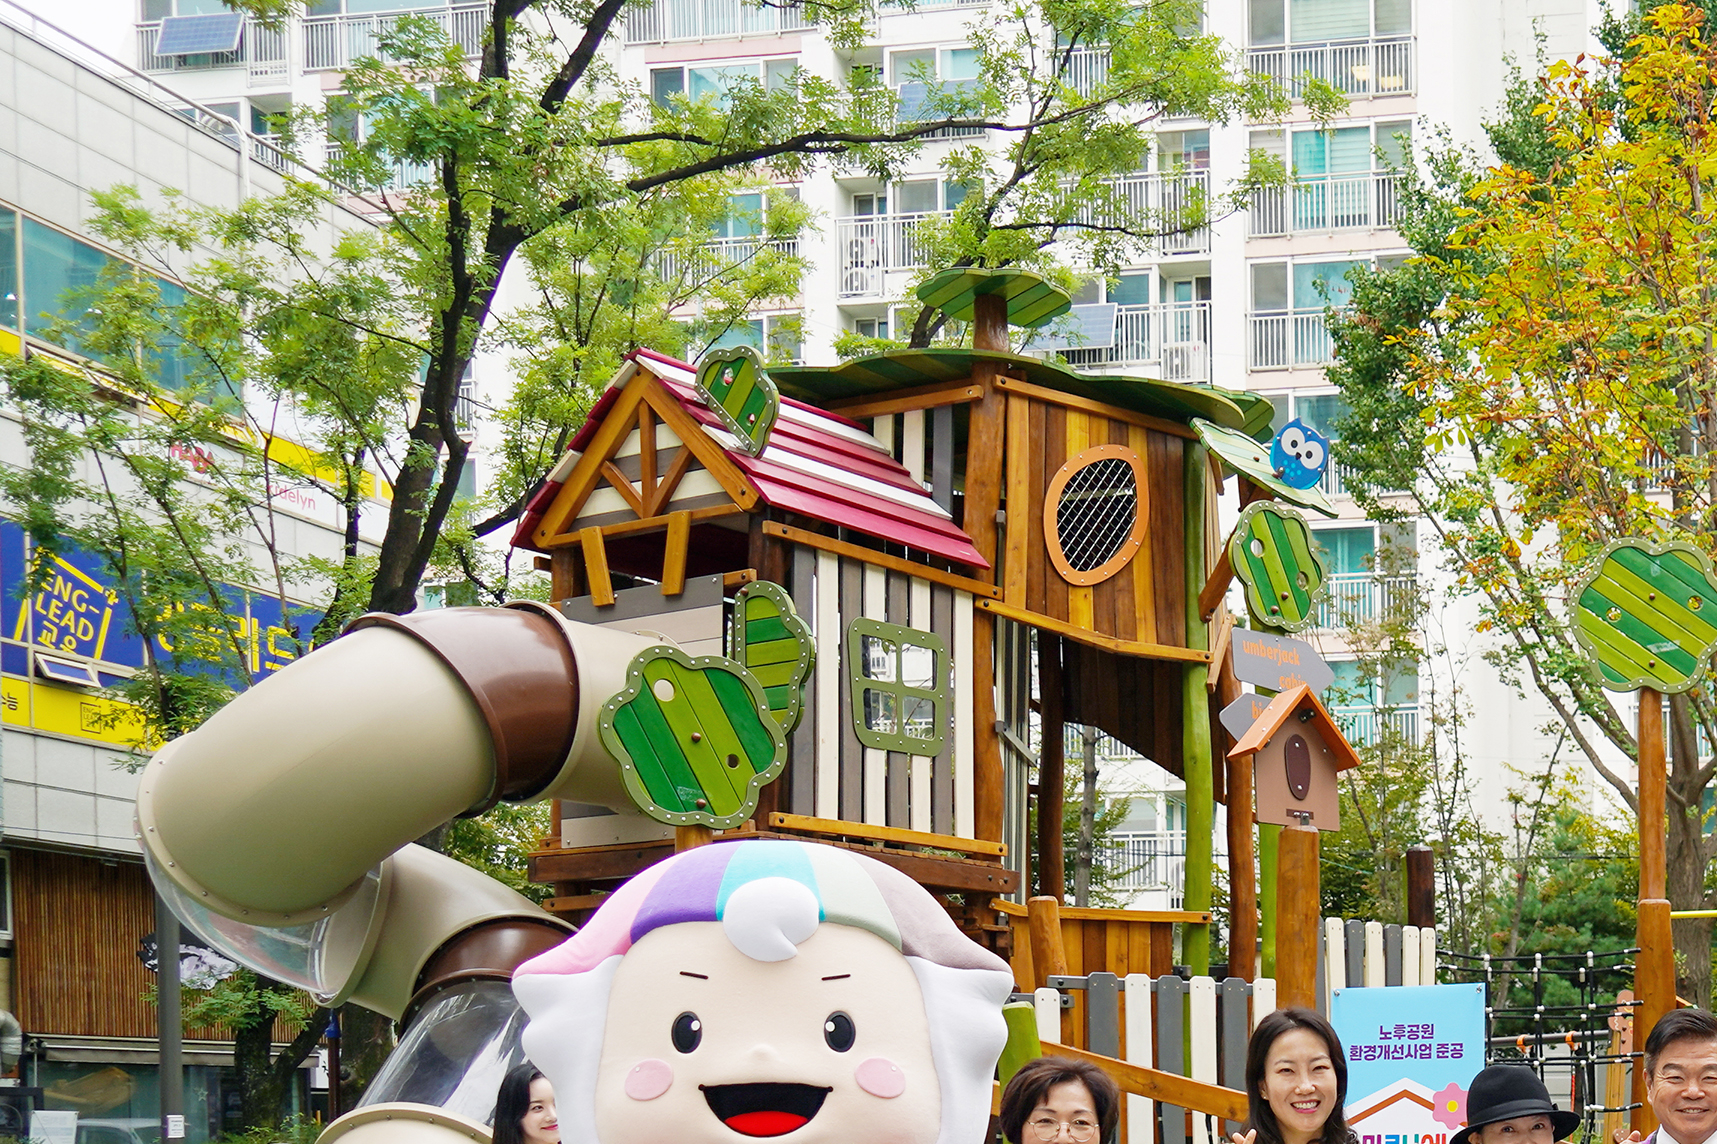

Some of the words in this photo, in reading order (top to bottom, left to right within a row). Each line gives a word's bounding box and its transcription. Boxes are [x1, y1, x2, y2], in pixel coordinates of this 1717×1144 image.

[34, 592, 95, 642] LEAD
[1242, 638, 1301, 666] umberjack
[1379, 1023, 1435, 1041] 노후공원
[1349, 1043, 1433, 1061] 환경개선사업
[1436, 1042, 1464, 1060] 준공
